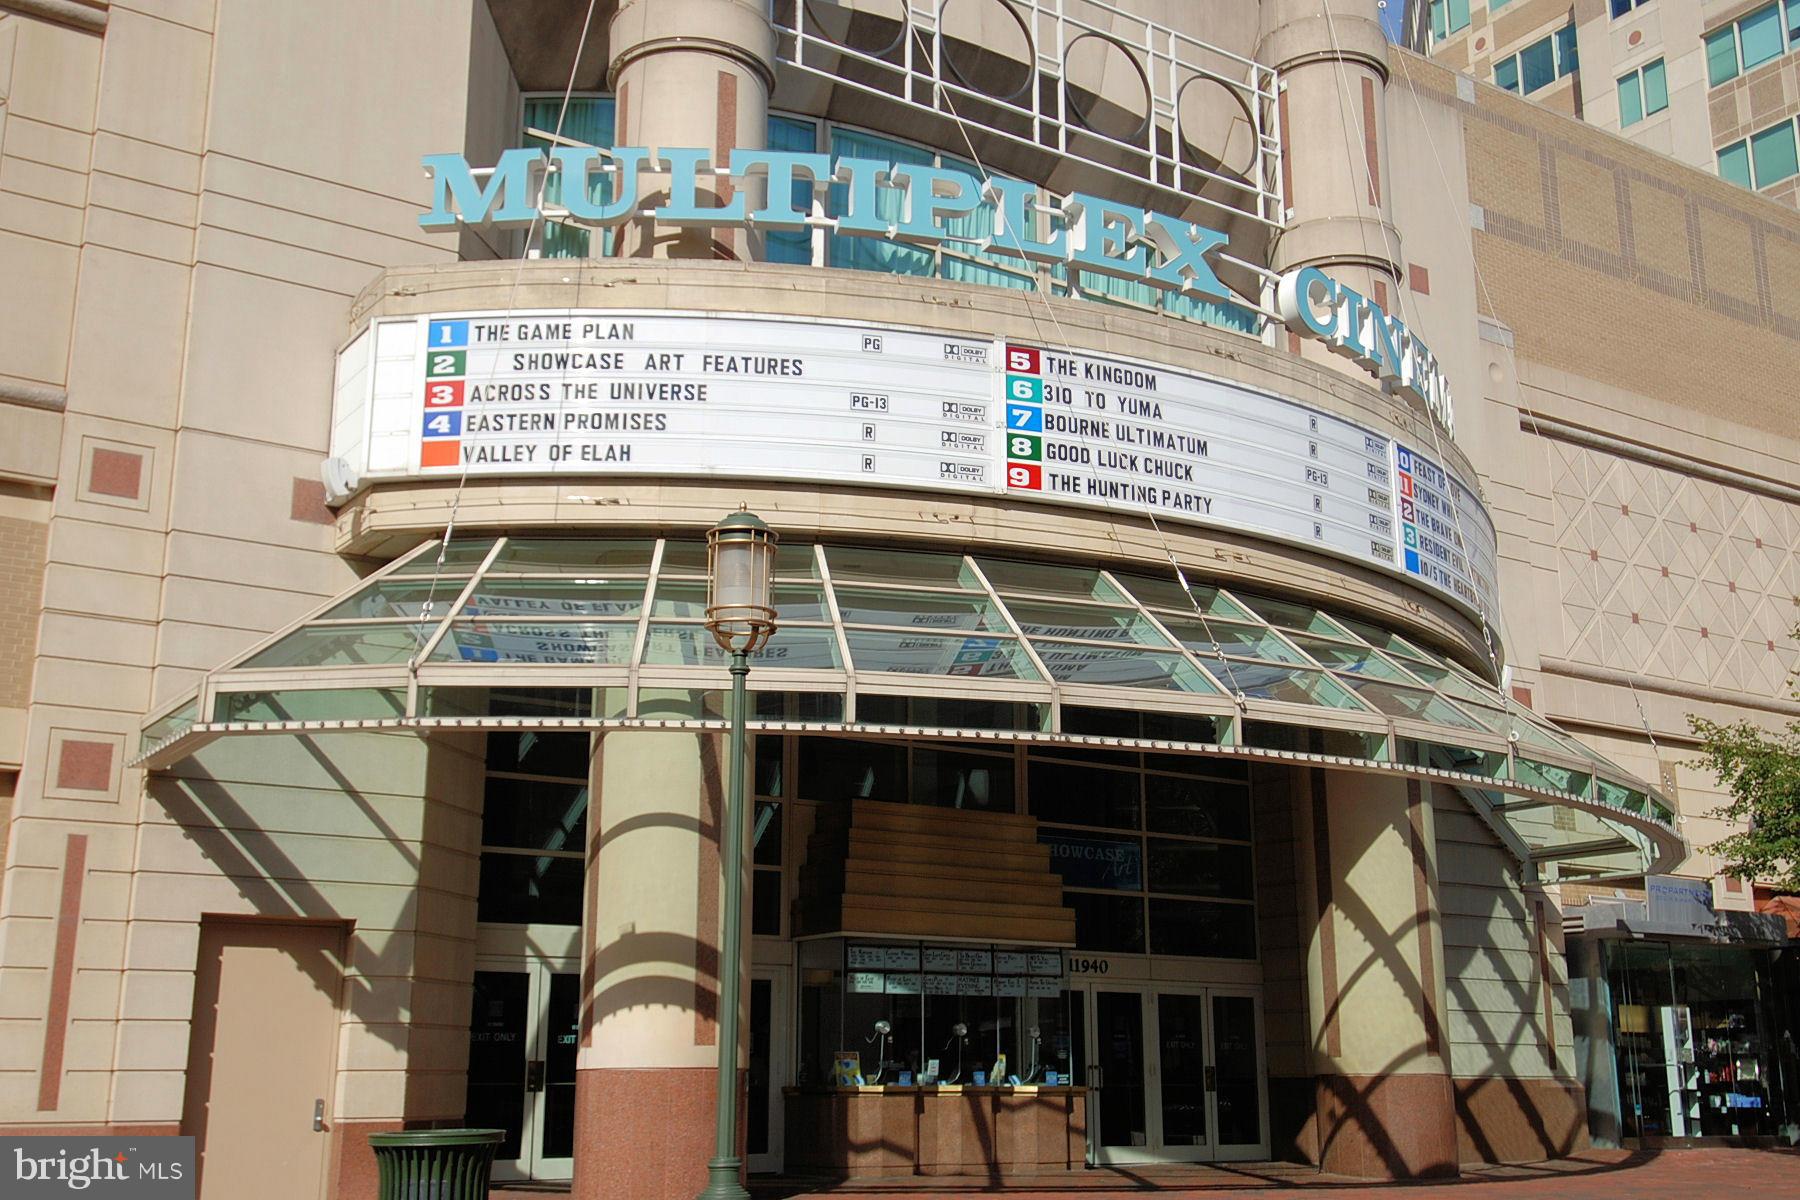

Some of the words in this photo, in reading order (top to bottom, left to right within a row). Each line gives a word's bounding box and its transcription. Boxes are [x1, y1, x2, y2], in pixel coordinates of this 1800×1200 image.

[418, 147, 1230, 300] MULTIPLEX
[440, 326, 452, 343] 1
[475, 325, 509, 342] THE
[518, 323, 571, 341] GAME
[583, 323, 634, 340] PLAN
[864, 338, 881, 350] PG
[433, 355, 455, 374] 2
[513, 353, 624, 370] SHOWCASE
[645, 354, 684, 371] ART
[703, 354, 803, 376] FEATURES
[945, 354, 986, 364] DIGITAL
[1010, 353, 1031, 370] 5
[1047, 357, 1077, 376] THE
[1085, 362, 1156, 391] KINGDOM
[431, 386, 454, 404] 3
[470, 383, 550, 402] ACROSS
[562, 383, 597, 400] THE
[610, 383, 707, 401] UNIVERSE
[1012, 380, 1033, 398] 6
[852, 396, 887, 409] PG-13
[1044, 385, 1072, 405] 310
[1085, 391, 1106, 410] TO
[1118, 396, 1162, 420] YUMA
[428, 415, 451, 433] 4
[466, 413, 555, 432] EASTERN
[564, 412, 667, 431] PROMISES
[943, 412, 985, 422] DIGITAL
[1012, 409, 1033, 427] 7
[865, 426, 873, 438] R
[961, 435, 981, 443] DOLBY
[1044, 414, 1110, 439] BOURNE
[1116, 425, 1208, 457] ULTIMATUM
[464, 445, 537, 462] VALLEY
[549, 444, 573, 461] OF
[581, 444, 631, 461] ELAH
[942, 442, 984, 451] DIGITAL
[1011, 438, 1032, 456] 8
[864, 457, 873, 470] R
[1047, 443, 1090, 464] GOOD
[1098, 450, 1139, 472] LUCK
[1144, 457, 1193, 482] CHUCK
[941, 472, 983, 482] DIGITAL
[1009, 467, 1029, 485] 9
[1307, 469, 1328, 485] PG-13
[1414, 460, 1435, 484] FEAST
[1438, 474, 1446, 491] OF
[1049, 473, 1080, 493] THE
[1087, 478, 1157, 504] HUNTING
[1162, 490, 1212, 514] PARTY
[1413, 483, 1439, 510] SYDNEY
[1401, 502, 1412, 519] 2
[1416, 509, 1430, 528] THE
[1431, 518, 1452, 541] BRAVE
[1406, 527, 1415, 545] 3
[1420, 535, 1451, 562] RESIDENT
[1452, 553, 1464, 573] EVIL
[1420, 560, 1438, 582] 10/5
[1439, 570, 1451, 589] THE
[1051, 843, 1125, 862] HOWCASE
[1069, 958, 1108, 974] 11940
[557, 1034, 576, 1044] EXIT
